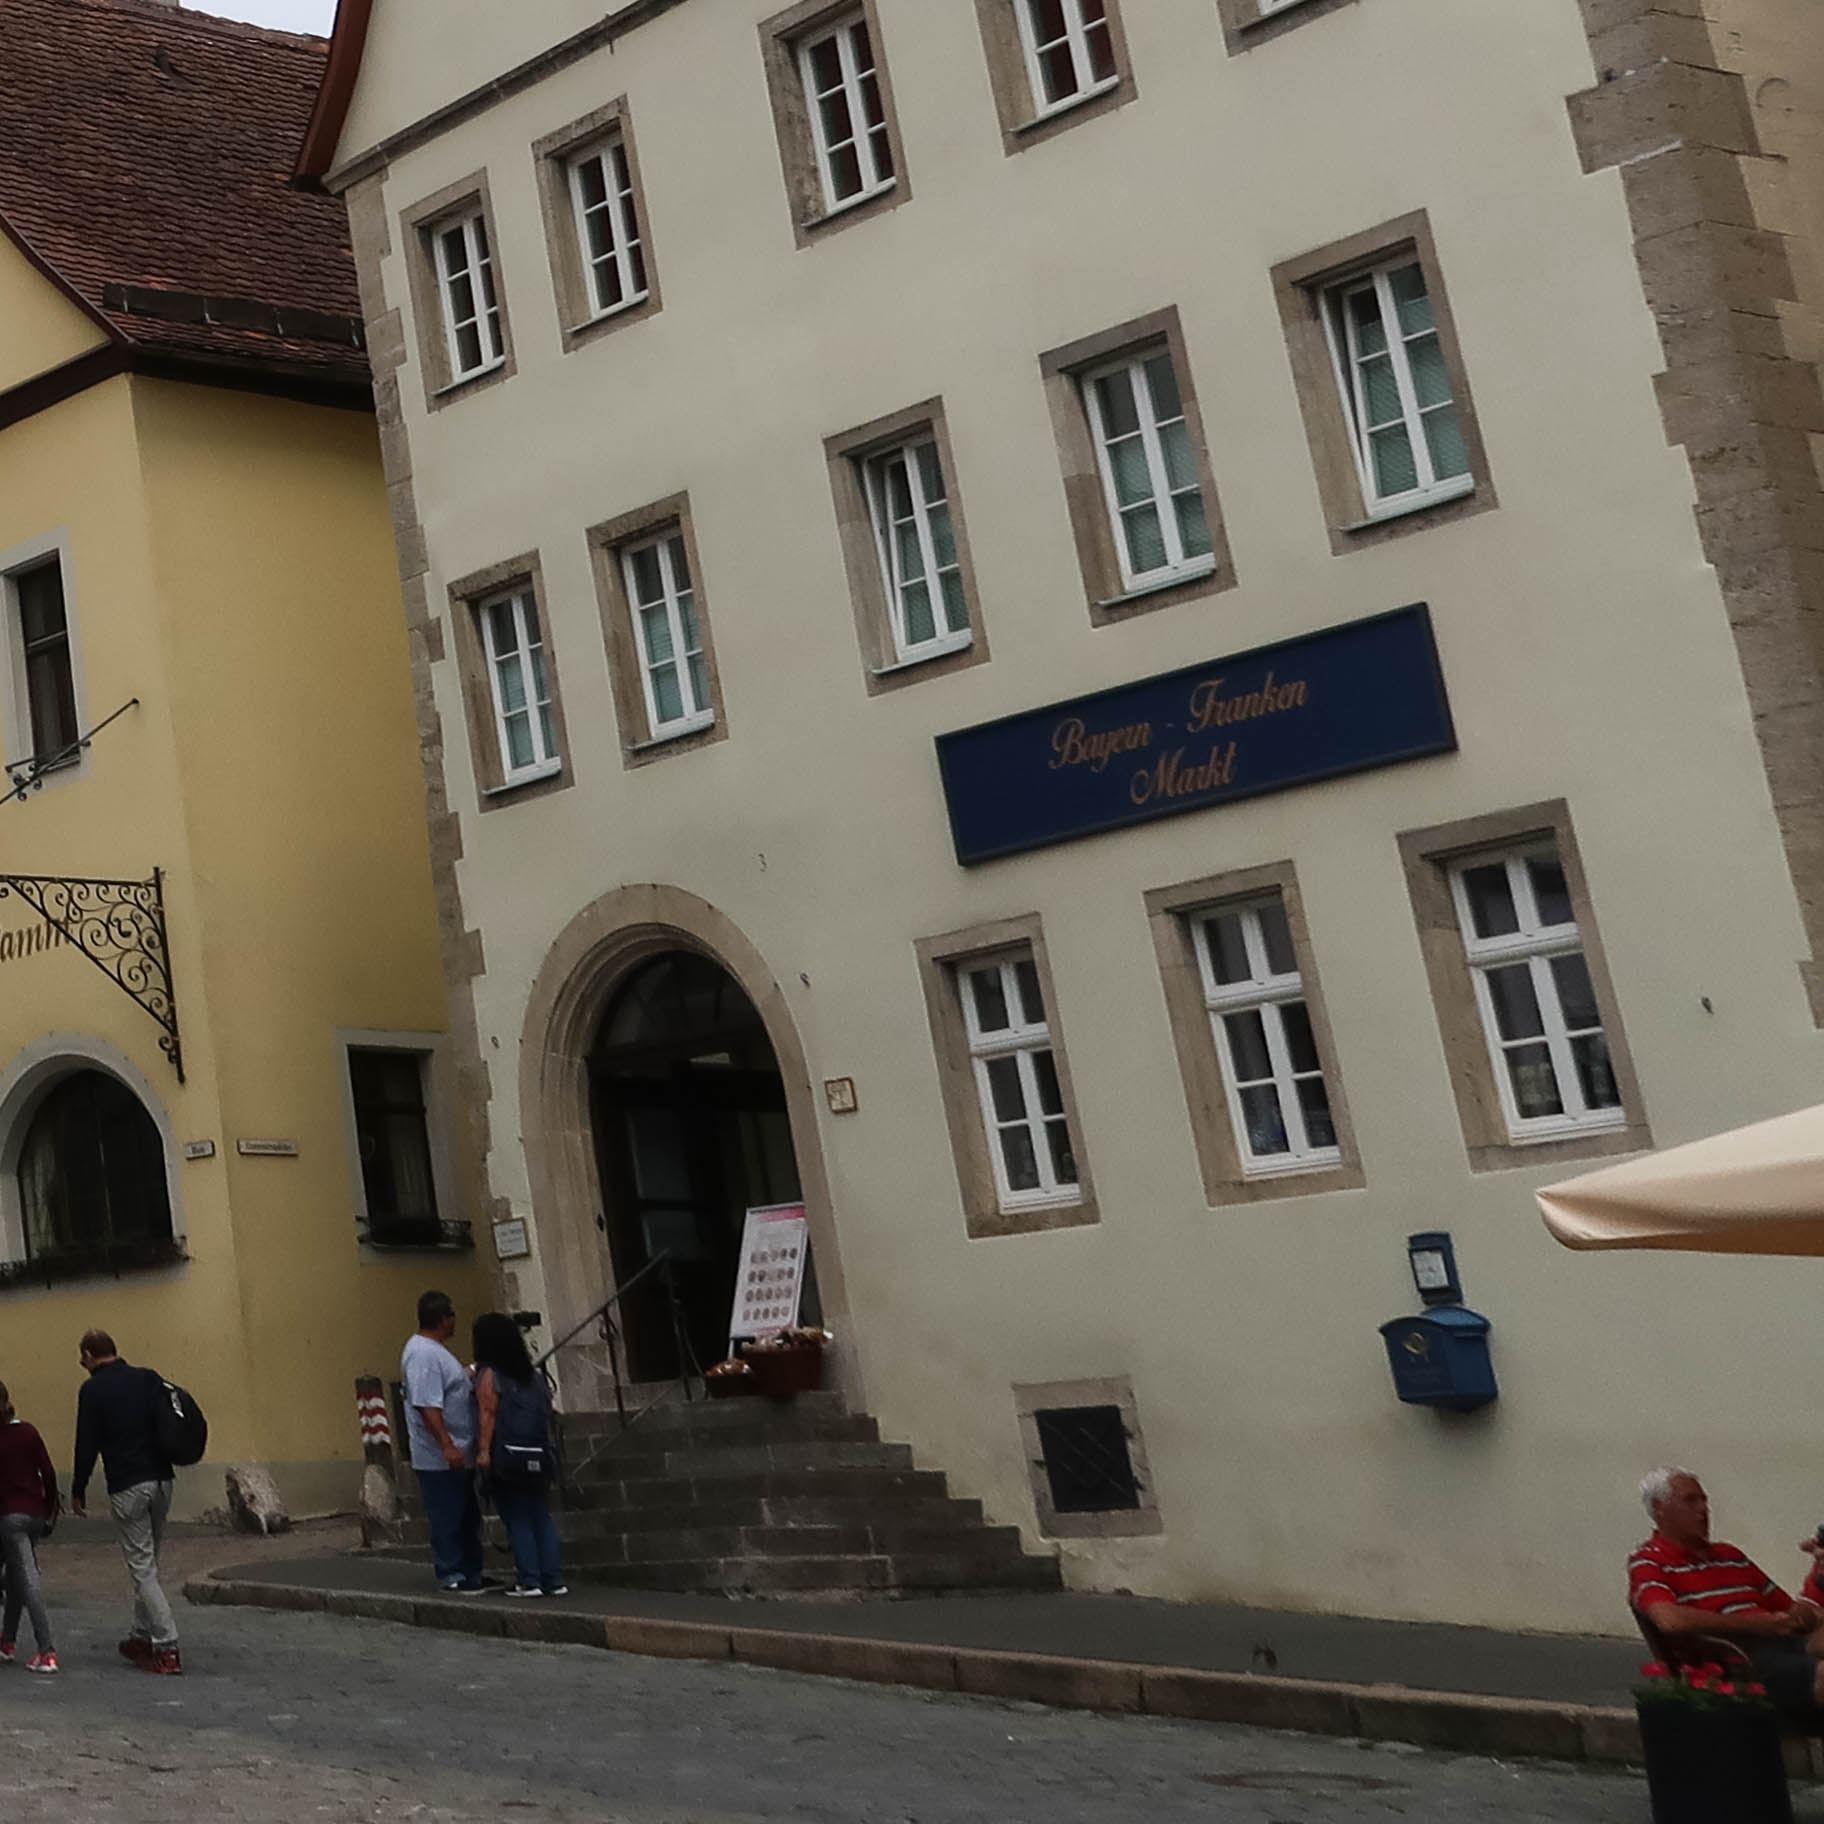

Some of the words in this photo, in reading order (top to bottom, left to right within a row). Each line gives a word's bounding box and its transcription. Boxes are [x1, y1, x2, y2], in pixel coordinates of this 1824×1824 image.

[1048, 717, 1152, 773] Bayern
[1186, 672, 1308, 733] Franken
[1130, 741, 1239, 805] Markt
